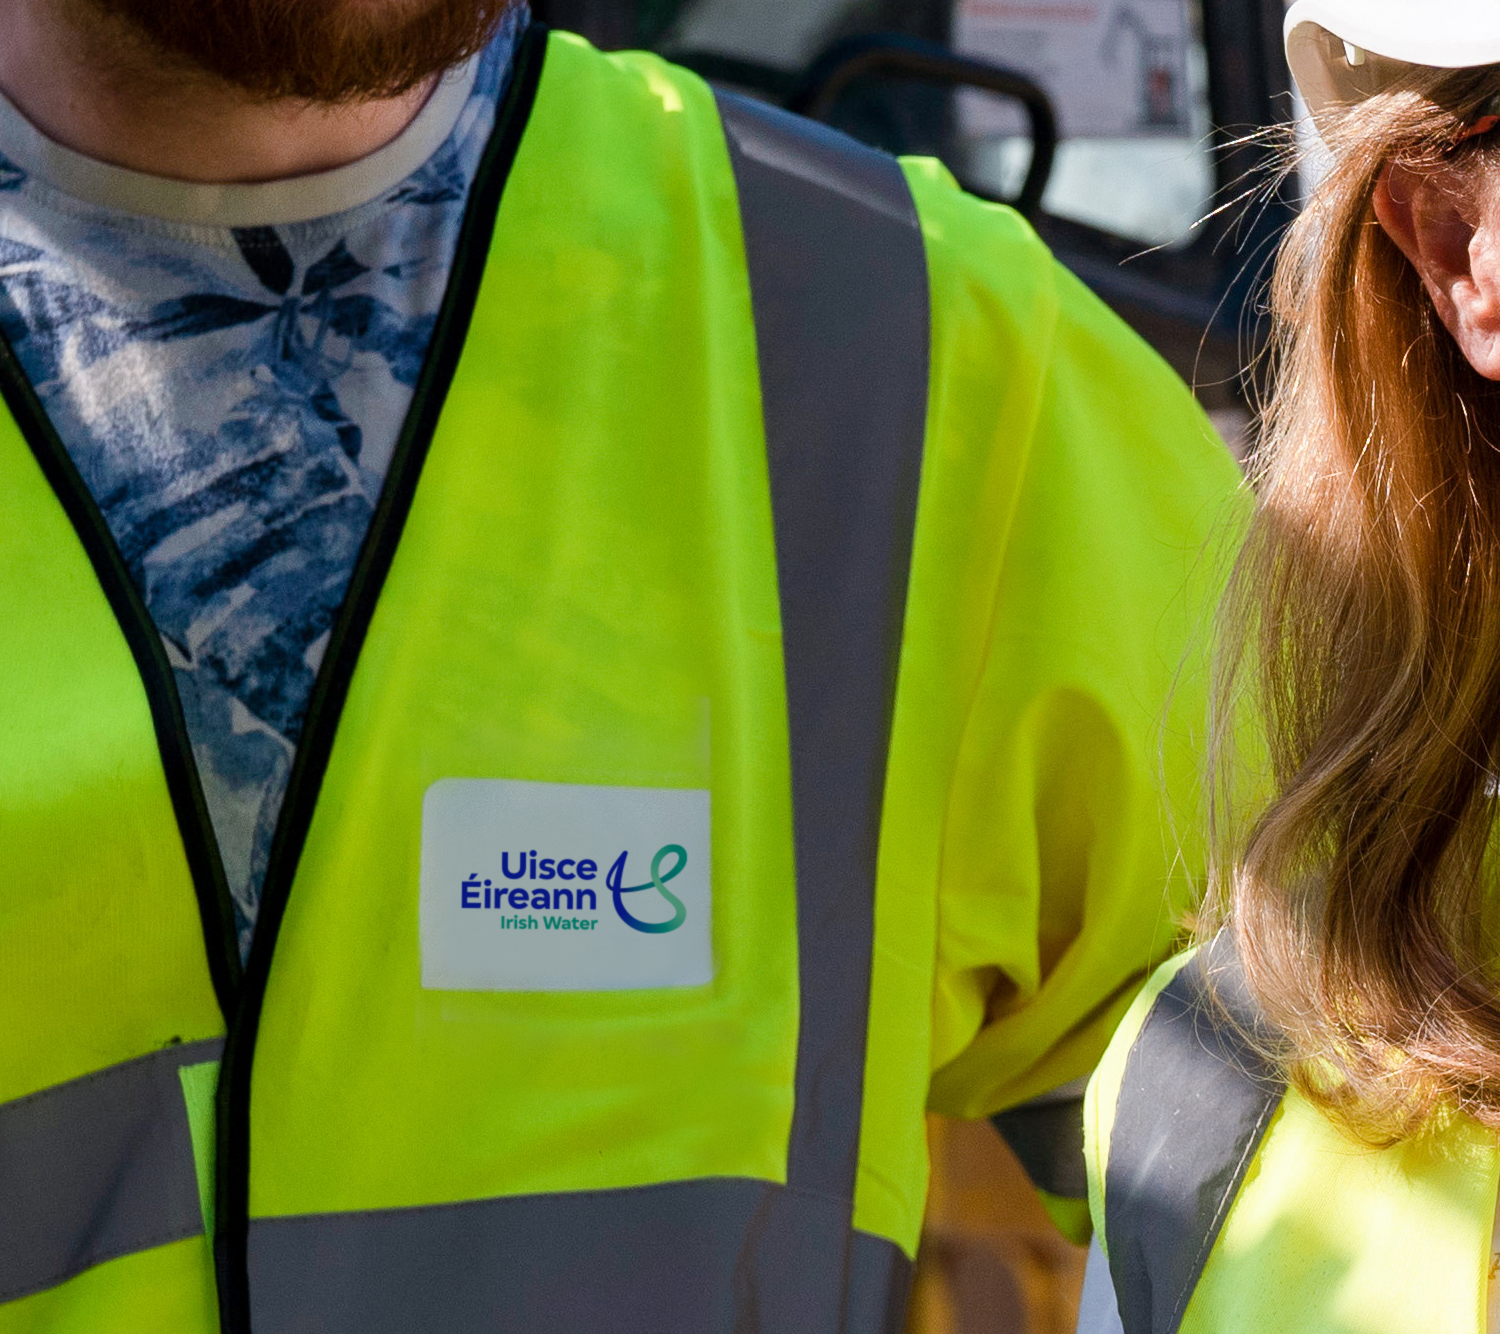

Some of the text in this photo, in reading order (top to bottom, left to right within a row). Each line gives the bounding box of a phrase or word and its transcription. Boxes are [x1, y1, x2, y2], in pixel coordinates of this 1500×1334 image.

[501, 849, 598, 881] Uisce
[460, 872, 597, 911] Éireann
[500, 914, 599, 931] Irish Water
